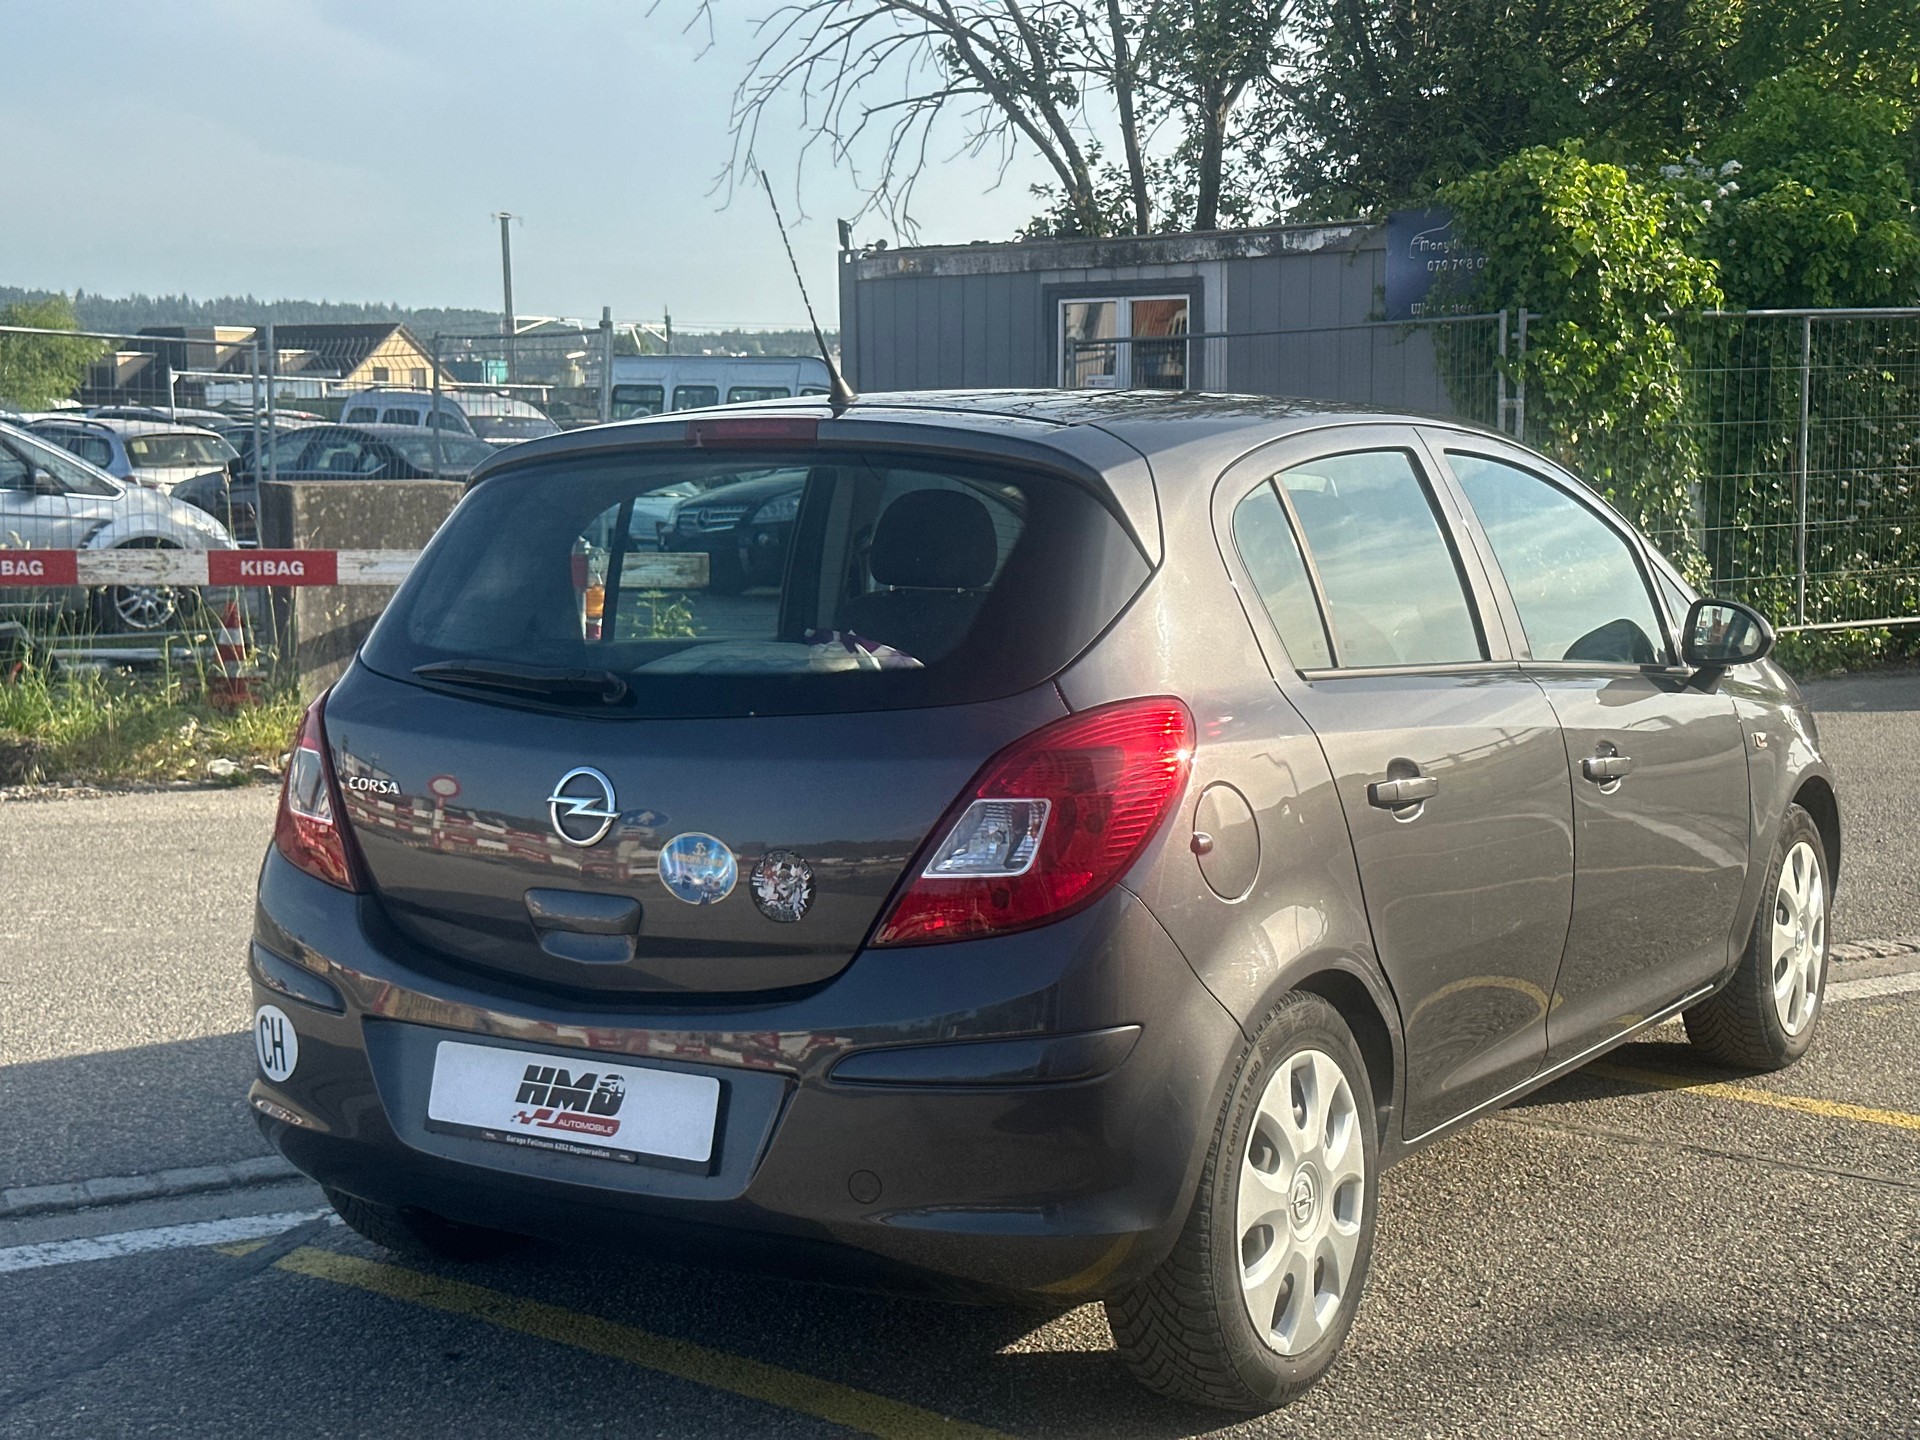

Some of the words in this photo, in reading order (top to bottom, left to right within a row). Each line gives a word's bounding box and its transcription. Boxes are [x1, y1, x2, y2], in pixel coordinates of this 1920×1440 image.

[240, 560, 304, 576] KIBAG
[348, 776, 401, 795] CORSA
[260, 1014, 286, 1072] CH
[1240, 1083, 1251, 1102] TS
[1247, 1060, 1262, 1085] 860
[558, 1119, 613, 1134] AUTOMOBILE
[506, 1134, 527, 1146] Garage
[554, 1143, 569, 1152] 6252
